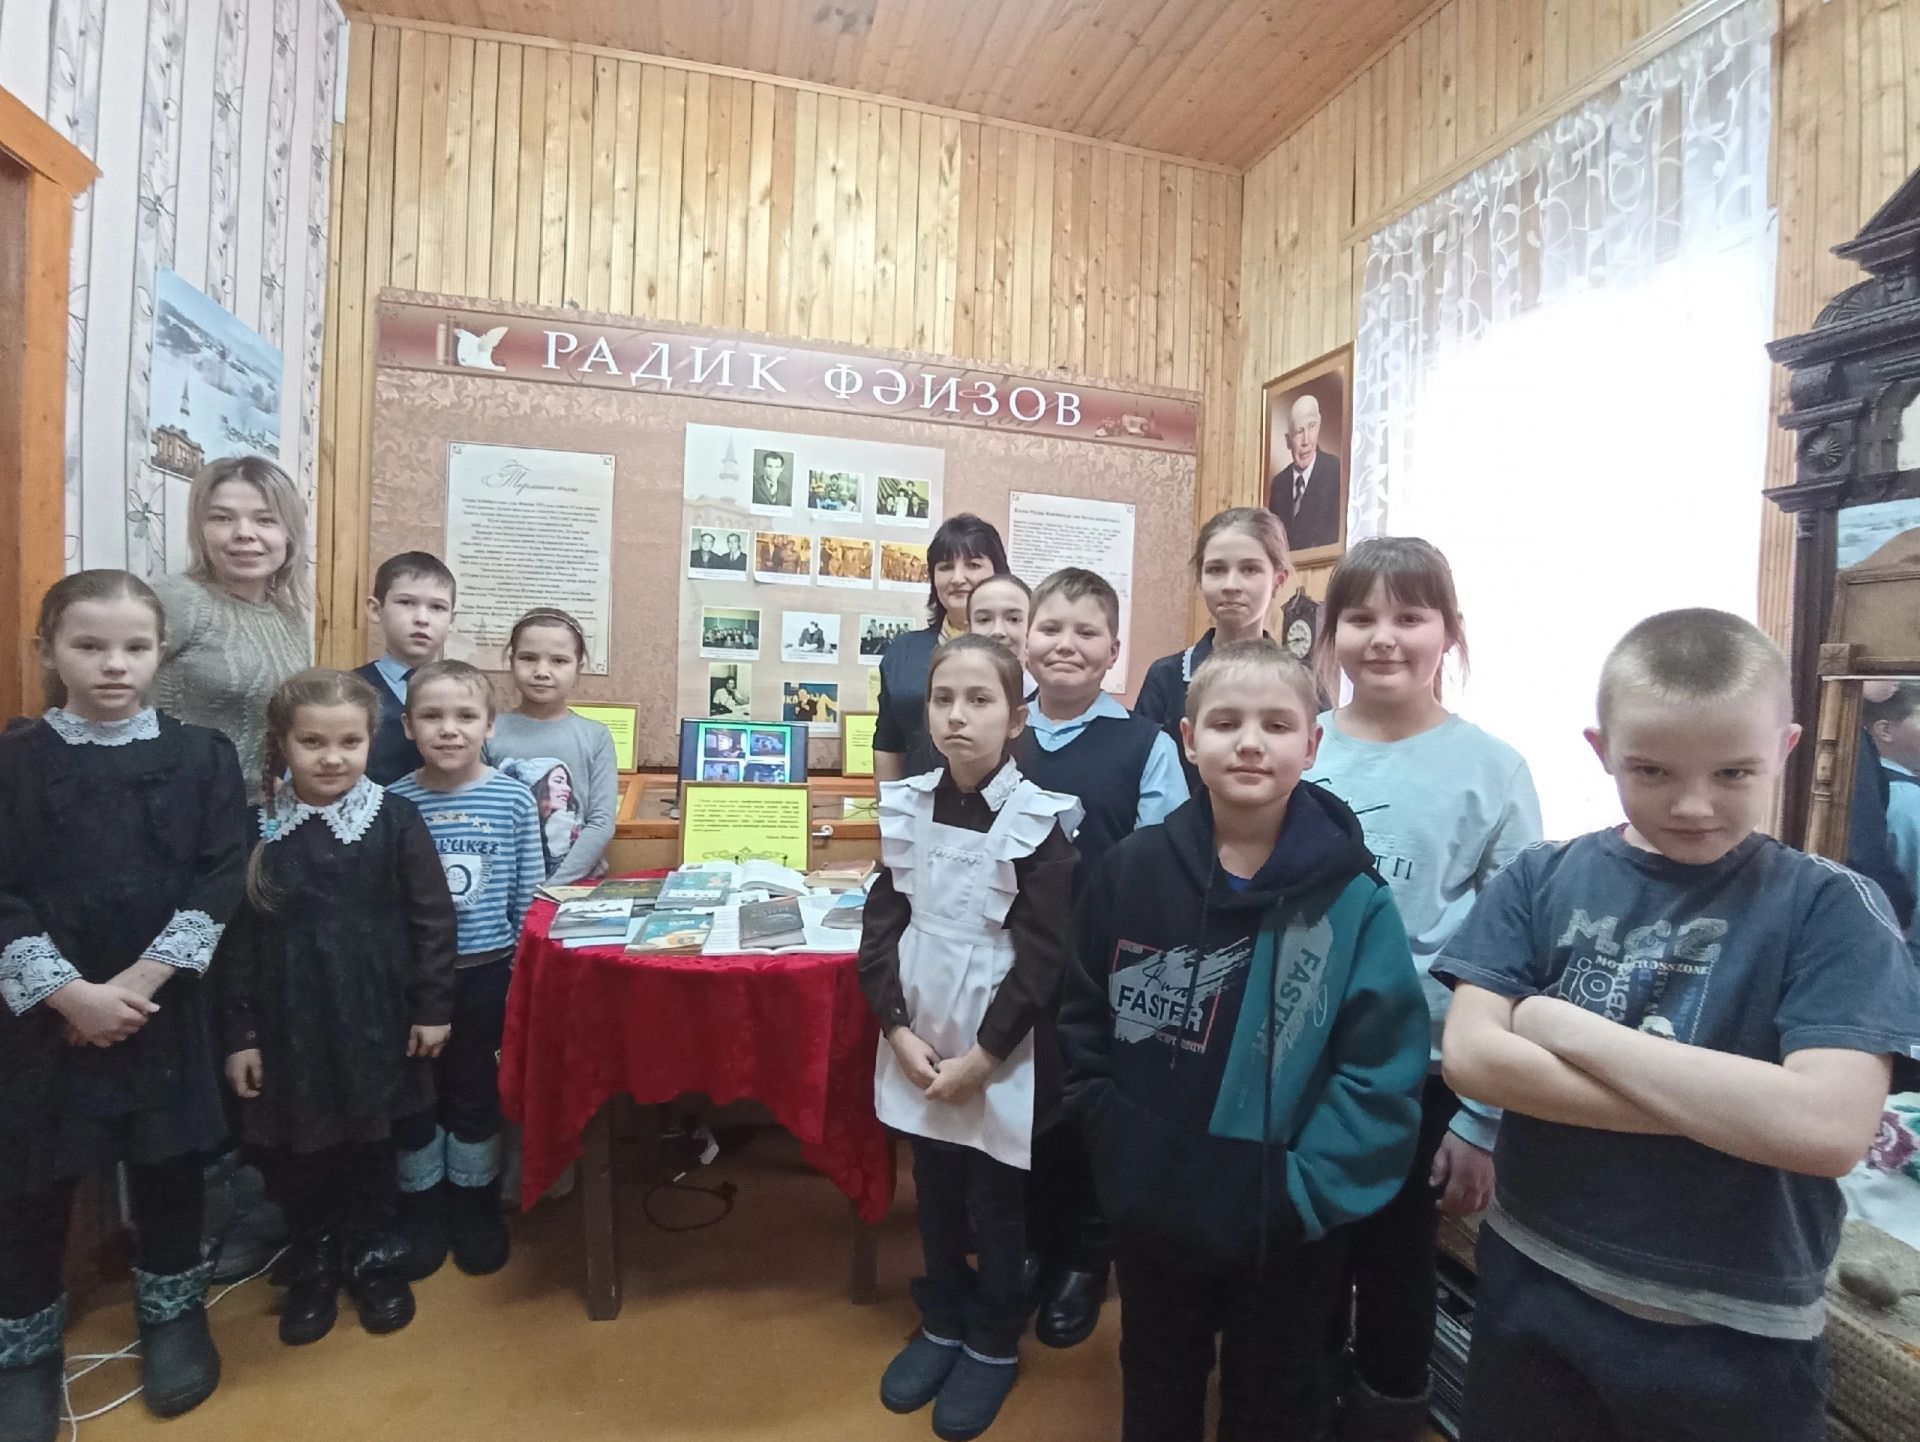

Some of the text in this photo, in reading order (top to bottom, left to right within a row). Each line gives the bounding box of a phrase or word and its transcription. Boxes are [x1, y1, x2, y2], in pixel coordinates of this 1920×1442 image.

[541, 330, 1082, 427] РАДИК ФӘИЗОВ
[1117, 984, 1204, 1032] FASTER
